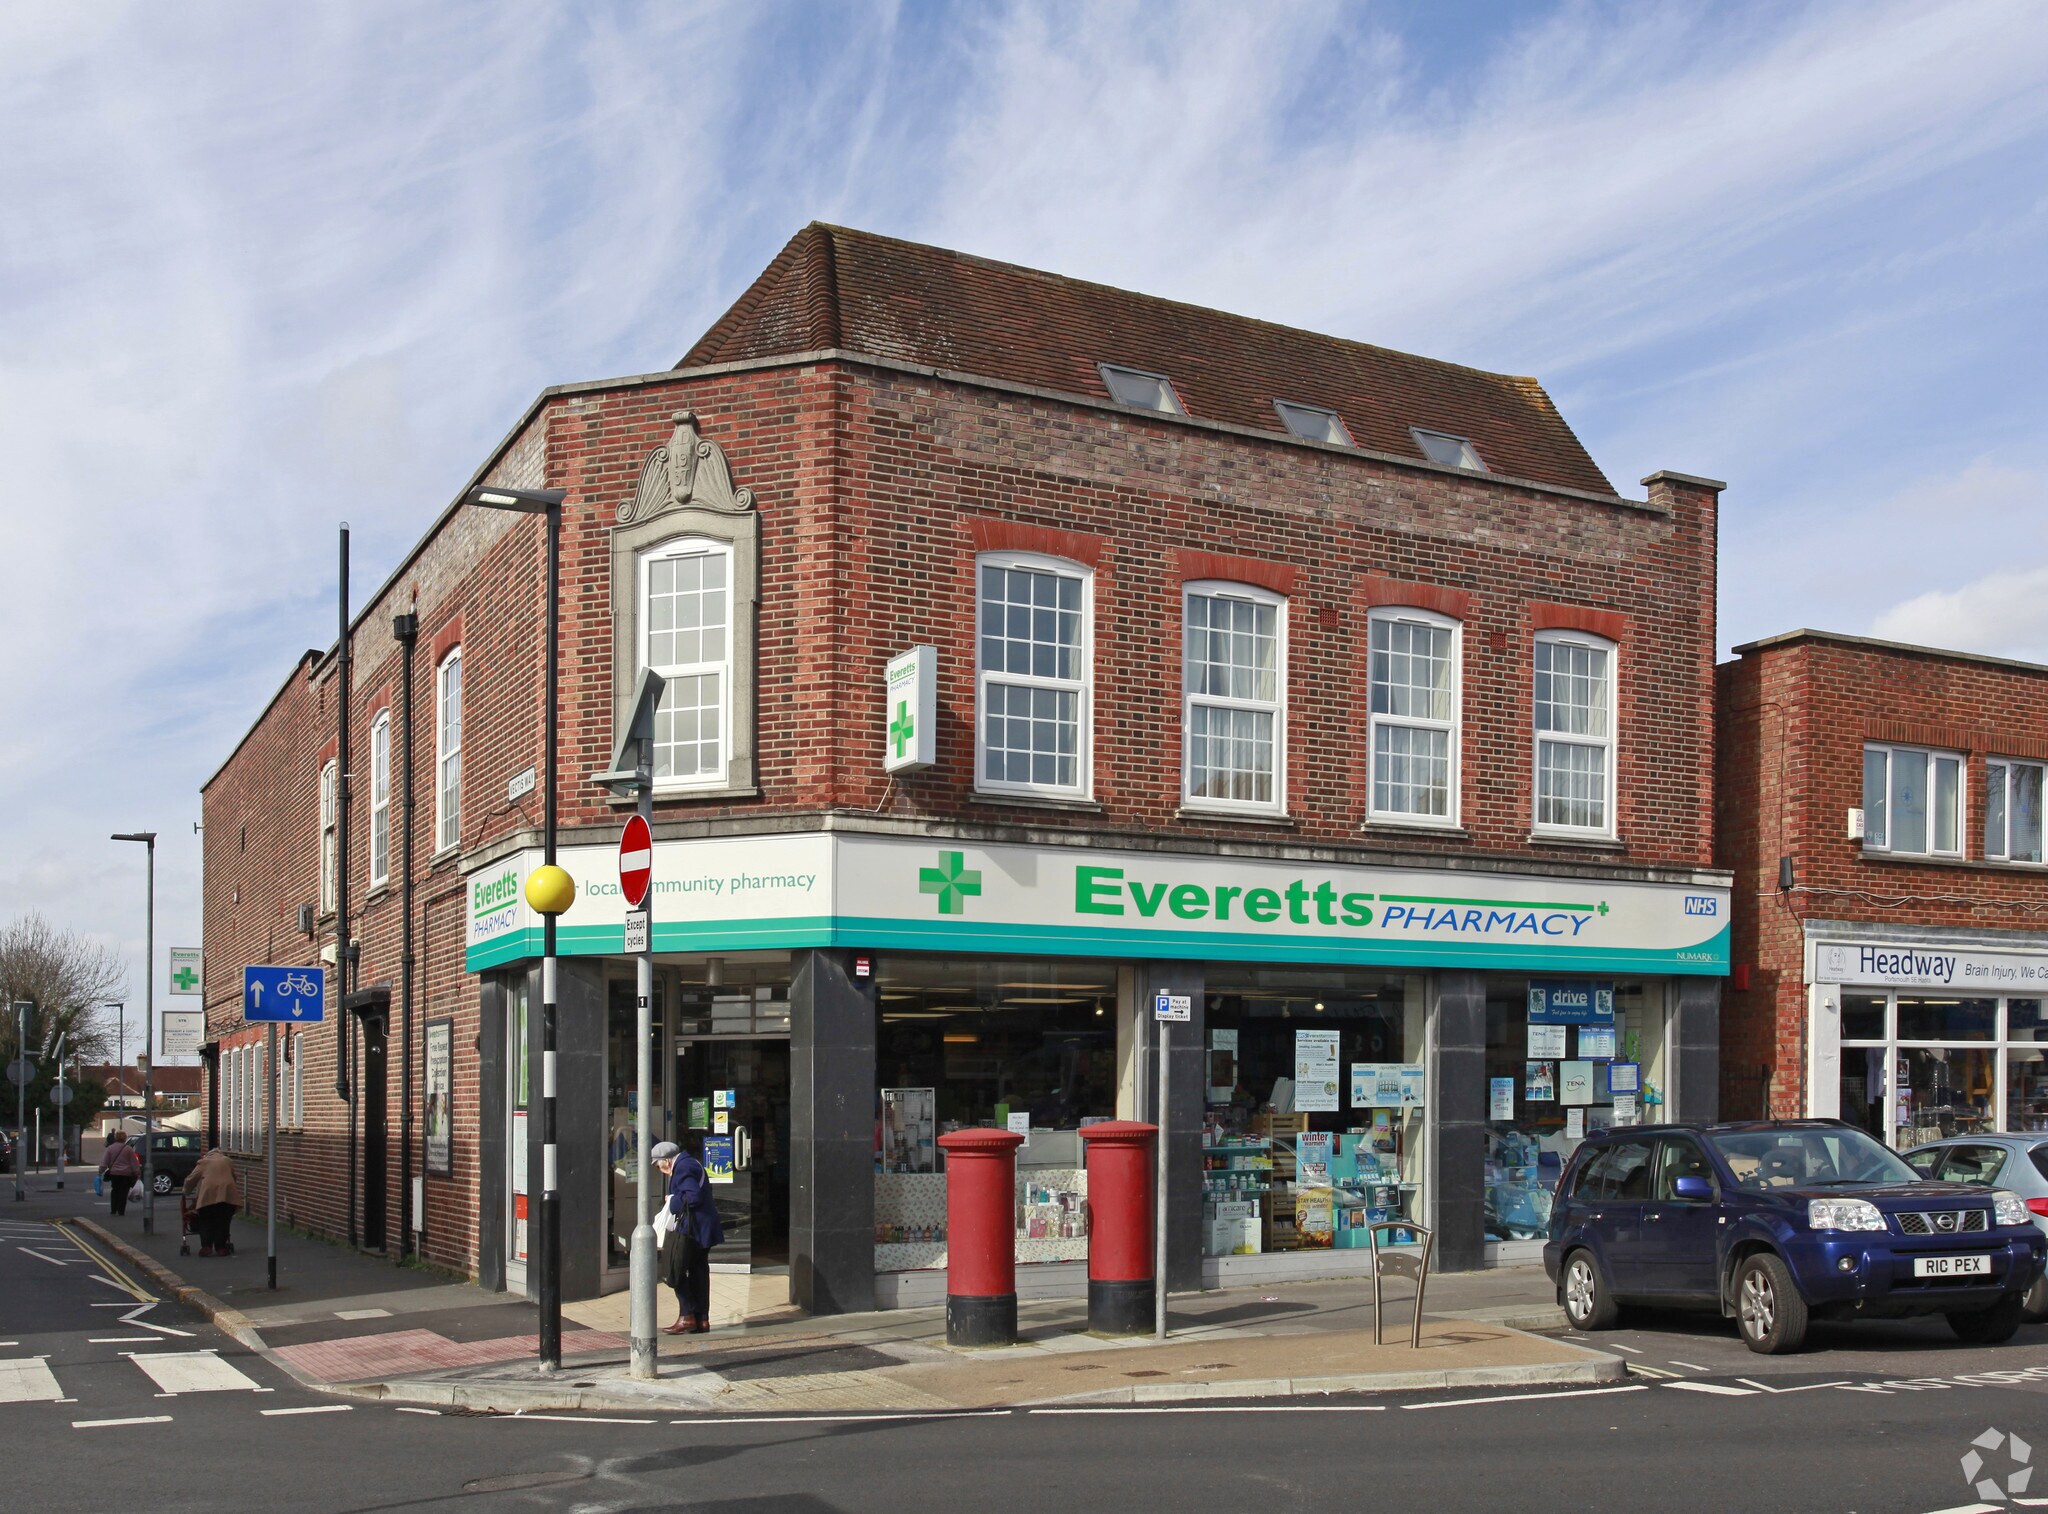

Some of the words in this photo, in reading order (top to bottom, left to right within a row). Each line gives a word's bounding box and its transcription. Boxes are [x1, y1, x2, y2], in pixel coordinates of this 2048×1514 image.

[675, 453, 687, 468] 19
[889, 662, 916, 681] Everetts
[889, 677, 915, 694] PHARMACY
[474, 869, 518, 910] Everetts
[652, 875, 725, 896] mmunity
[731, 873, 816, 895] pharmacy
[1075, 865, 1375, 927] Everetts
[1685, 897, 1715, 915] NHS
[473, 907, 518, 939] PHARMACY
[626, 918, 645, 931] Except
[1380, 906, 1592, 936] PHARMACY
[626, 934, 645, 946] cycles
[1676, 952, 1713, 961] NUMARK
[1860, 946, 1956, 984] Headway
[1885, 975, 1910, 983] Portsmouth
[1965, 963, 1989, 977] Brain
[1991, 965, 2017, 981] Injury,
[2020, 966, 2035, 978] We
[1160, 998, 1168, 1010] P
[1552, 989, 1588, 1003] drive
[1301, 1132, 1329, 1141] winter
[1955, 1258, 1980, 1272] PEX
